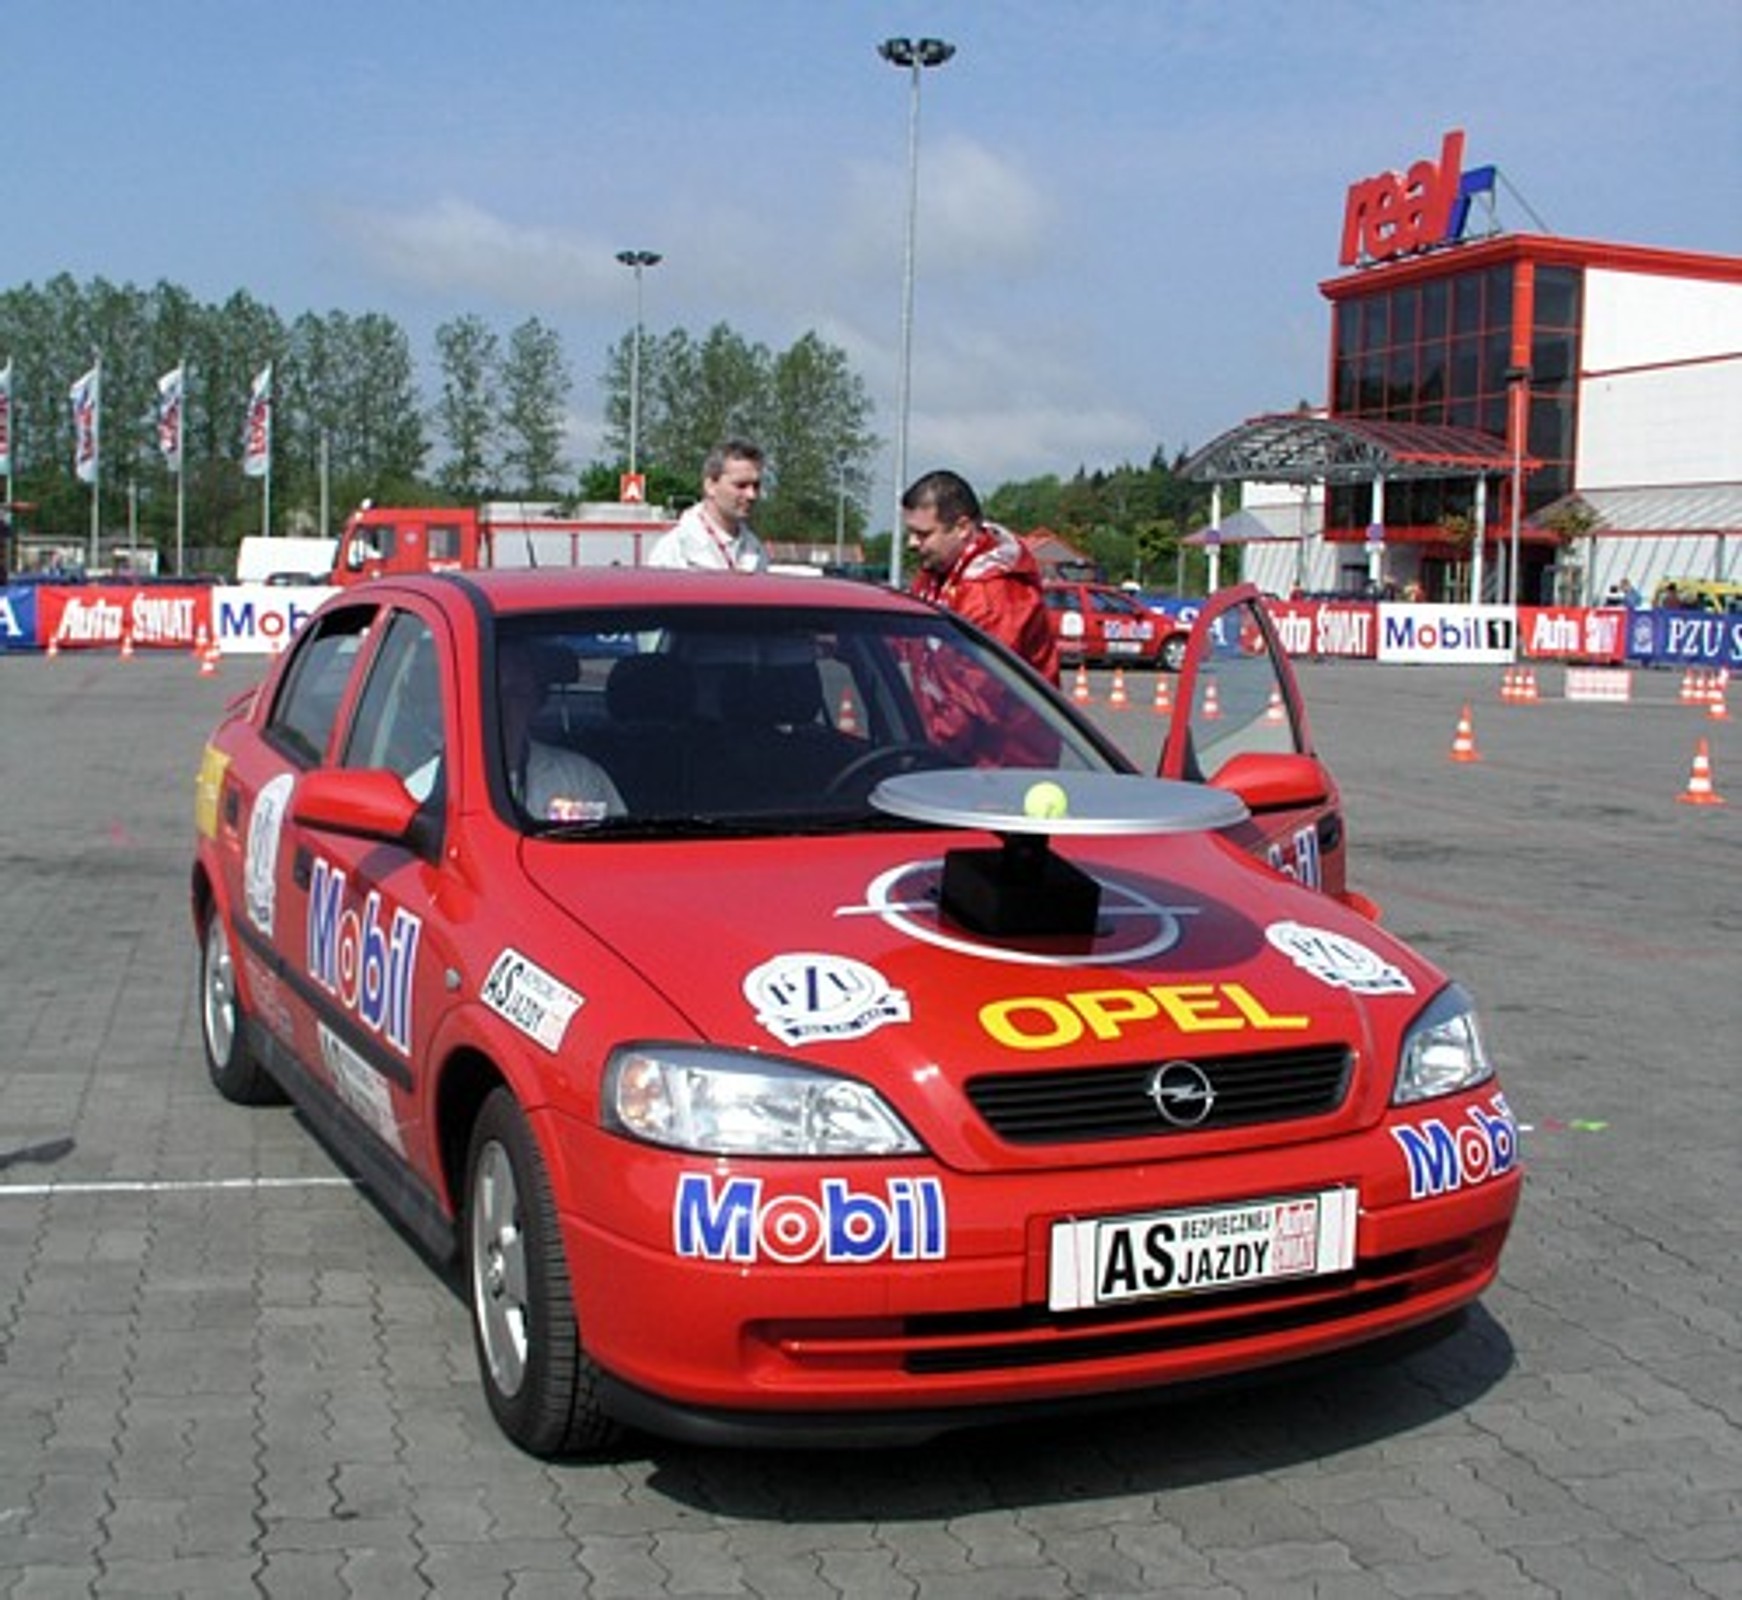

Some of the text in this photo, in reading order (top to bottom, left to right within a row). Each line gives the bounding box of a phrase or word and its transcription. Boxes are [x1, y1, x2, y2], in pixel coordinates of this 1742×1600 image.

[57, 598, 124, 640] Auto
[1386, 616, 1482, 649] Mobil
[1667, 619, 1723, 656] PZU
[308, 856, 422, 1057] Mobil
[979, 984, 1310, 1050] OPEL
[675, 1173, 946, 1263] Mobil
[1181, 1210, 1270, 1240] BEZPIECZNEJ
[1101, 1223, 1176, 1294] AS
[1178, 1240, 1269, 1284] JAZDY
